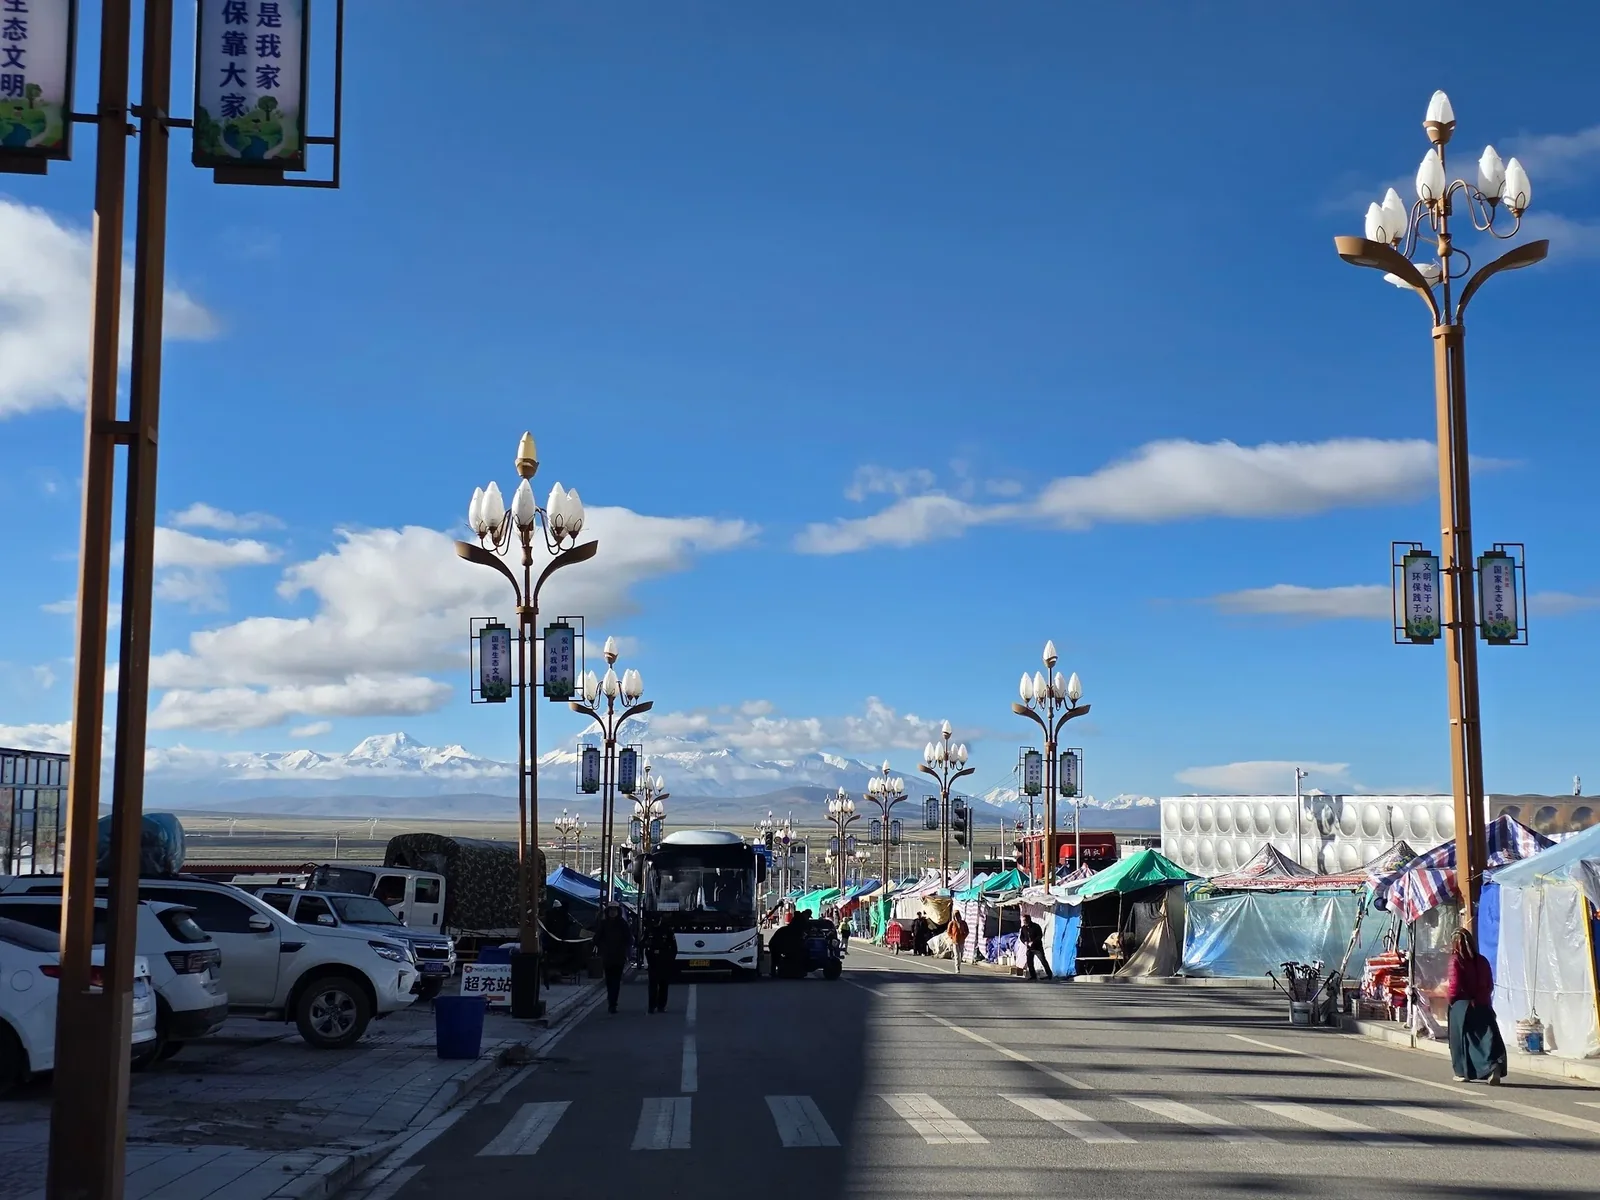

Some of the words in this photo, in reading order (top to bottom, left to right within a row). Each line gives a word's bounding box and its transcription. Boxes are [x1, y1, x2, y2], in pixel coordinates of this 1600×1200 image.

[219, 0, 249, 119] 保靠大家
[256, 2, 282, 90] 是我家
[1412, 572, 1422, 624] 环保践于行
[1423, 562, 1433, 614] 文明始于心
[1493, 565, 1503, 621] 国家生态文明
[491, 635, 499, 682] 国家生态文明
[549, 647, 557, 682] 从我做起
[463, 976, 513, 992] 超充站
